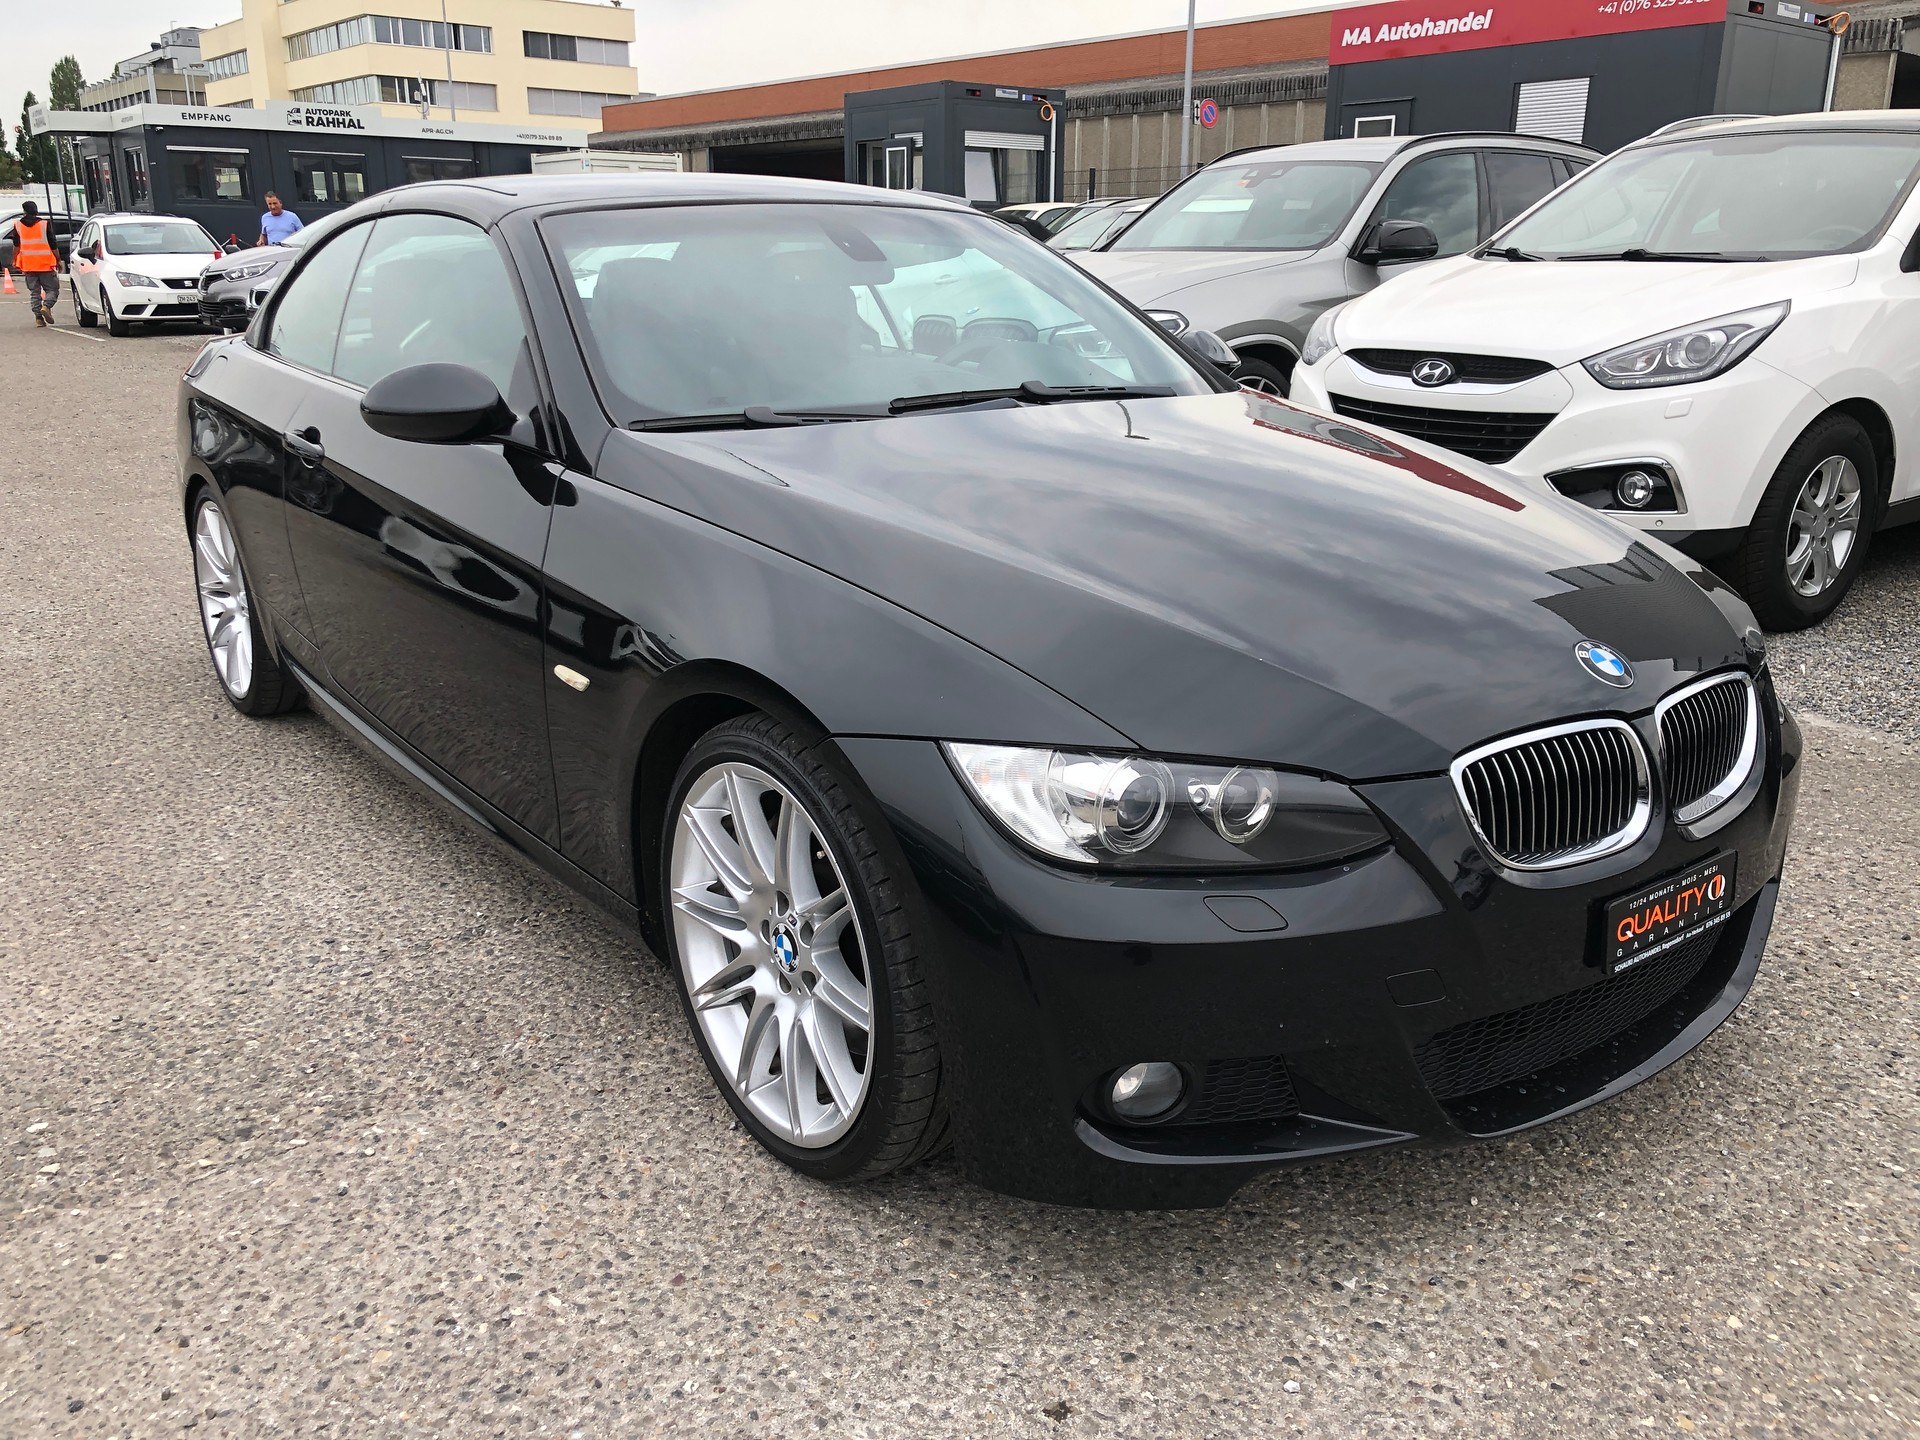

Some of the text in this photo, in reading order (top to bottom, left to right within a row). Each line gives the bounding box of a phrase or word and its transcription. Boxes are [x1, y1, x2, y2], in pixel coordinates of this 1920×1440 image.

[1597, 2, 1618, 13] +41
[1341, 9, 1493, 47] MA Autohandel
[181, 112, 232, 122] EMPFANG
[305, 108, 352, 117] AUTOPARK
[305, 116, 365, 130] RAHHAL
[421, 127, 454, 135] APR-AG.CH
[1629, 896, 1647, 910] 12/24
[1649, 884, 1675, 901] MONATE
[1681, 874, 1697, 887] MOIS
[1704, 865, 1719, 877] MESI
[1633, 945, 1662, 964] AUTOHANDEL
